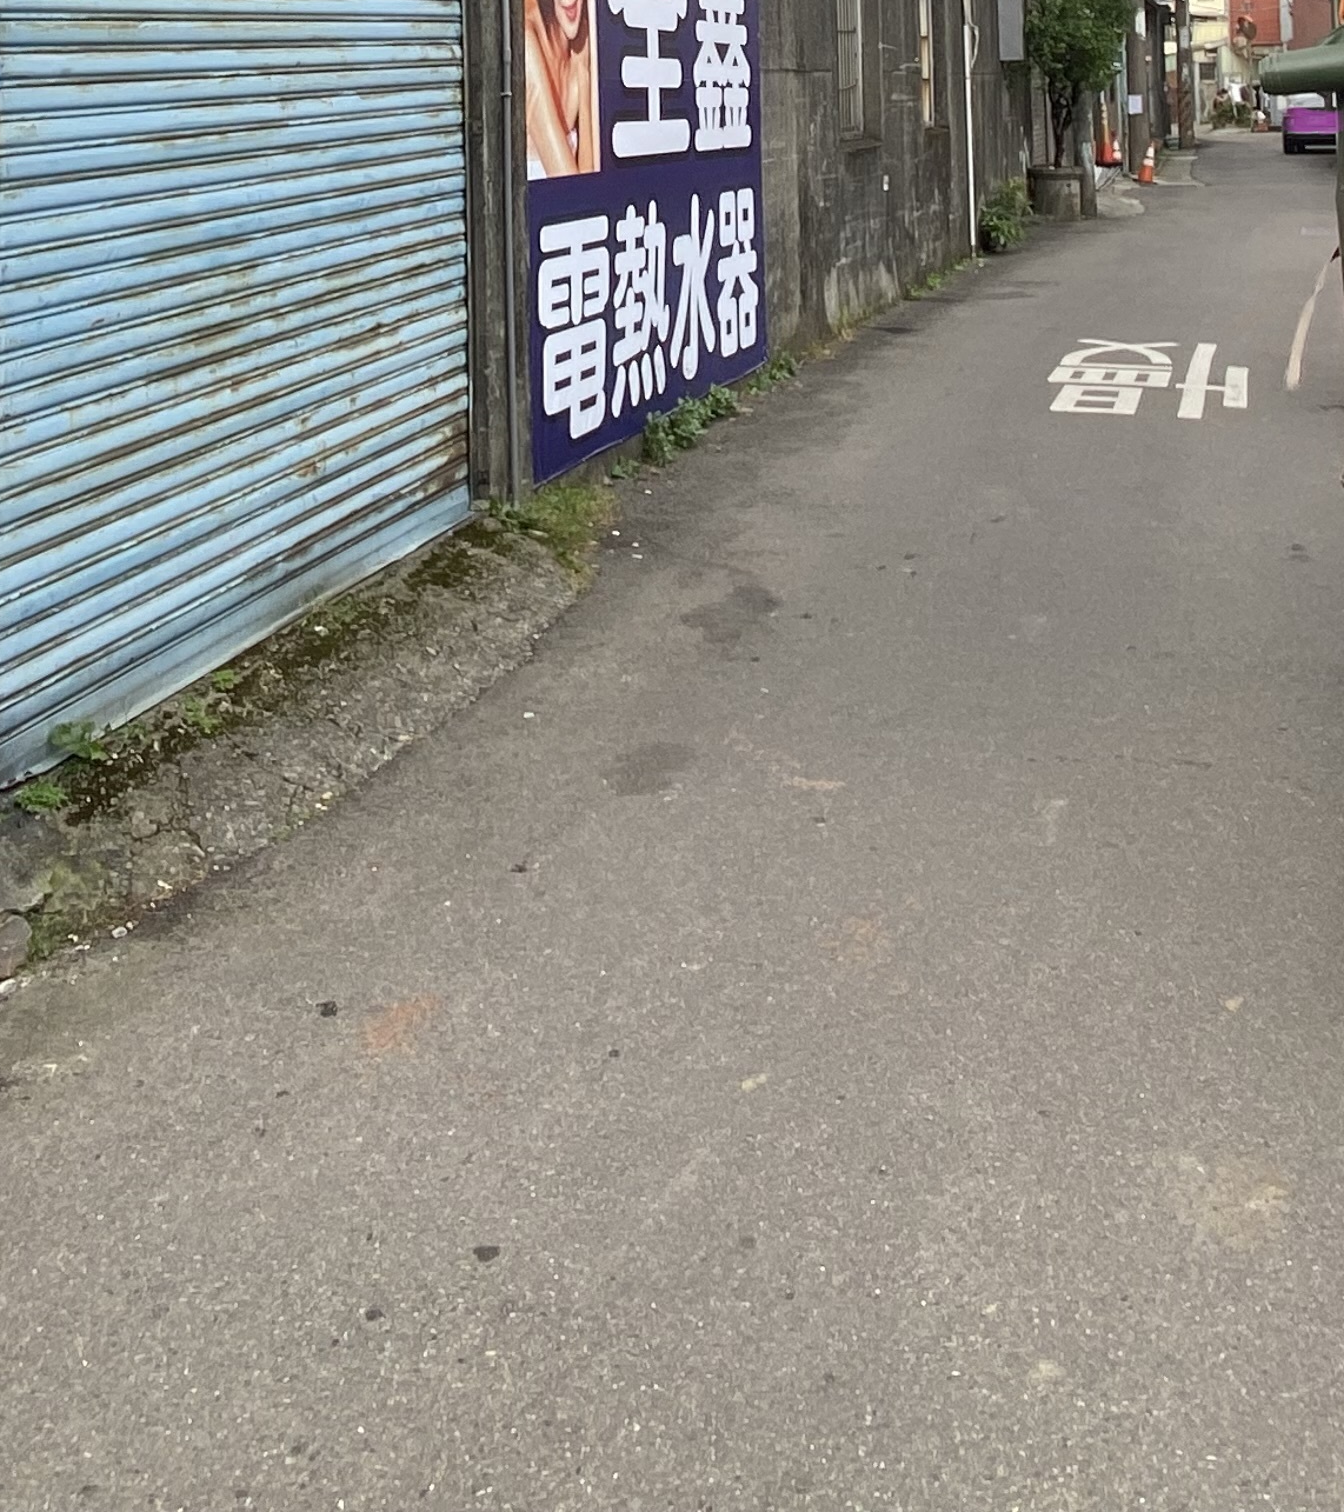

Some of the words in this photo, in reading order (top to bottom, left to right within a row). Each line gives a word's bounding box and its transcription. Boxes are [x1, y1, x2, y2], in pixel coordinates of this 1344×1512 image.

[538, 188, 759, 440] 電熱水器
[1047, 338, 1250, 419] 慢
